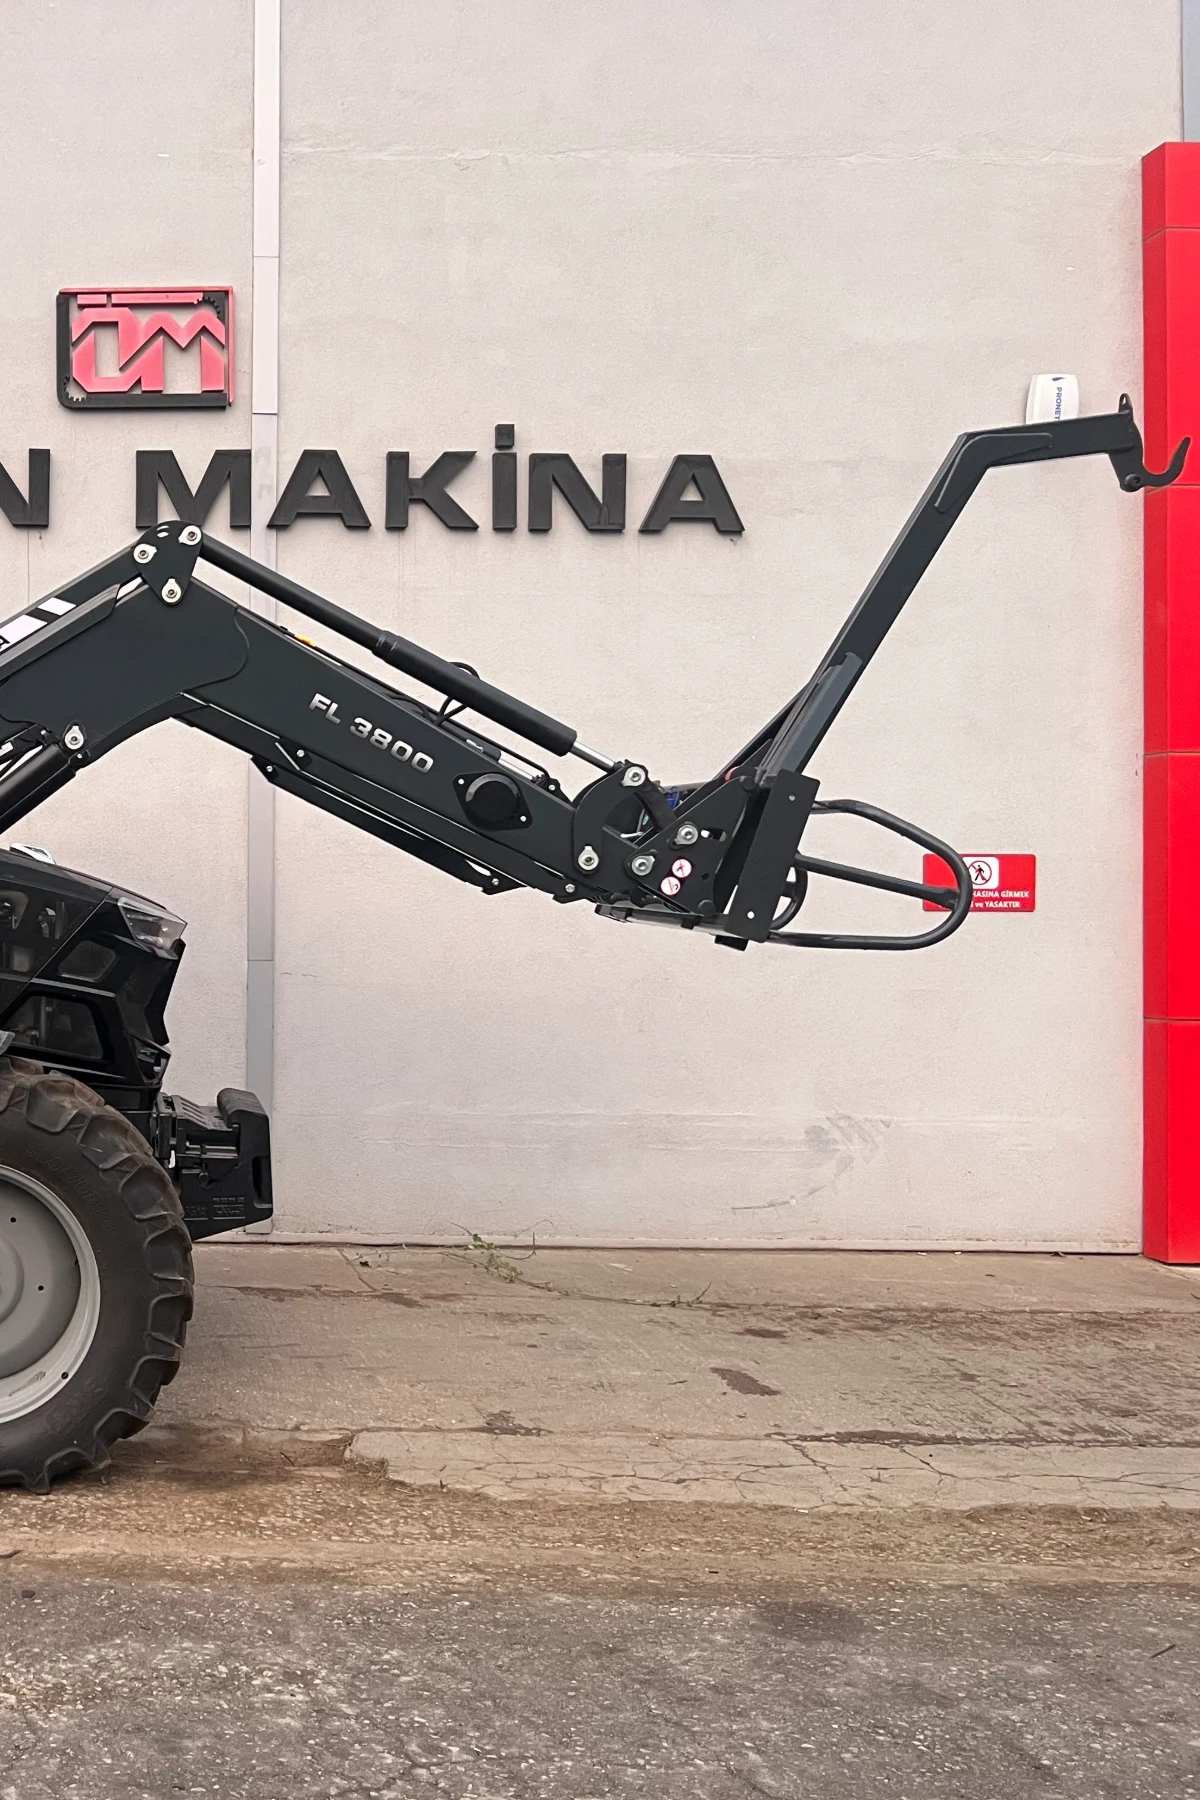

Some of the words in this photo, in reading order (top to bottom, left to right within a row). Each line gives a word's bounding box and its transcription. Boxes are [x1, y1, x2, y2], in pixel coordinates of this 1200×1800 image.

[135, 423, 745, 534] MAKİNA
[308, 692, 341, 725] FL
[349, 716, 434, 774] 3800
[972, 890, 999, 898] HASINA
[1001, 889, 1029, 898] GİRMEK
